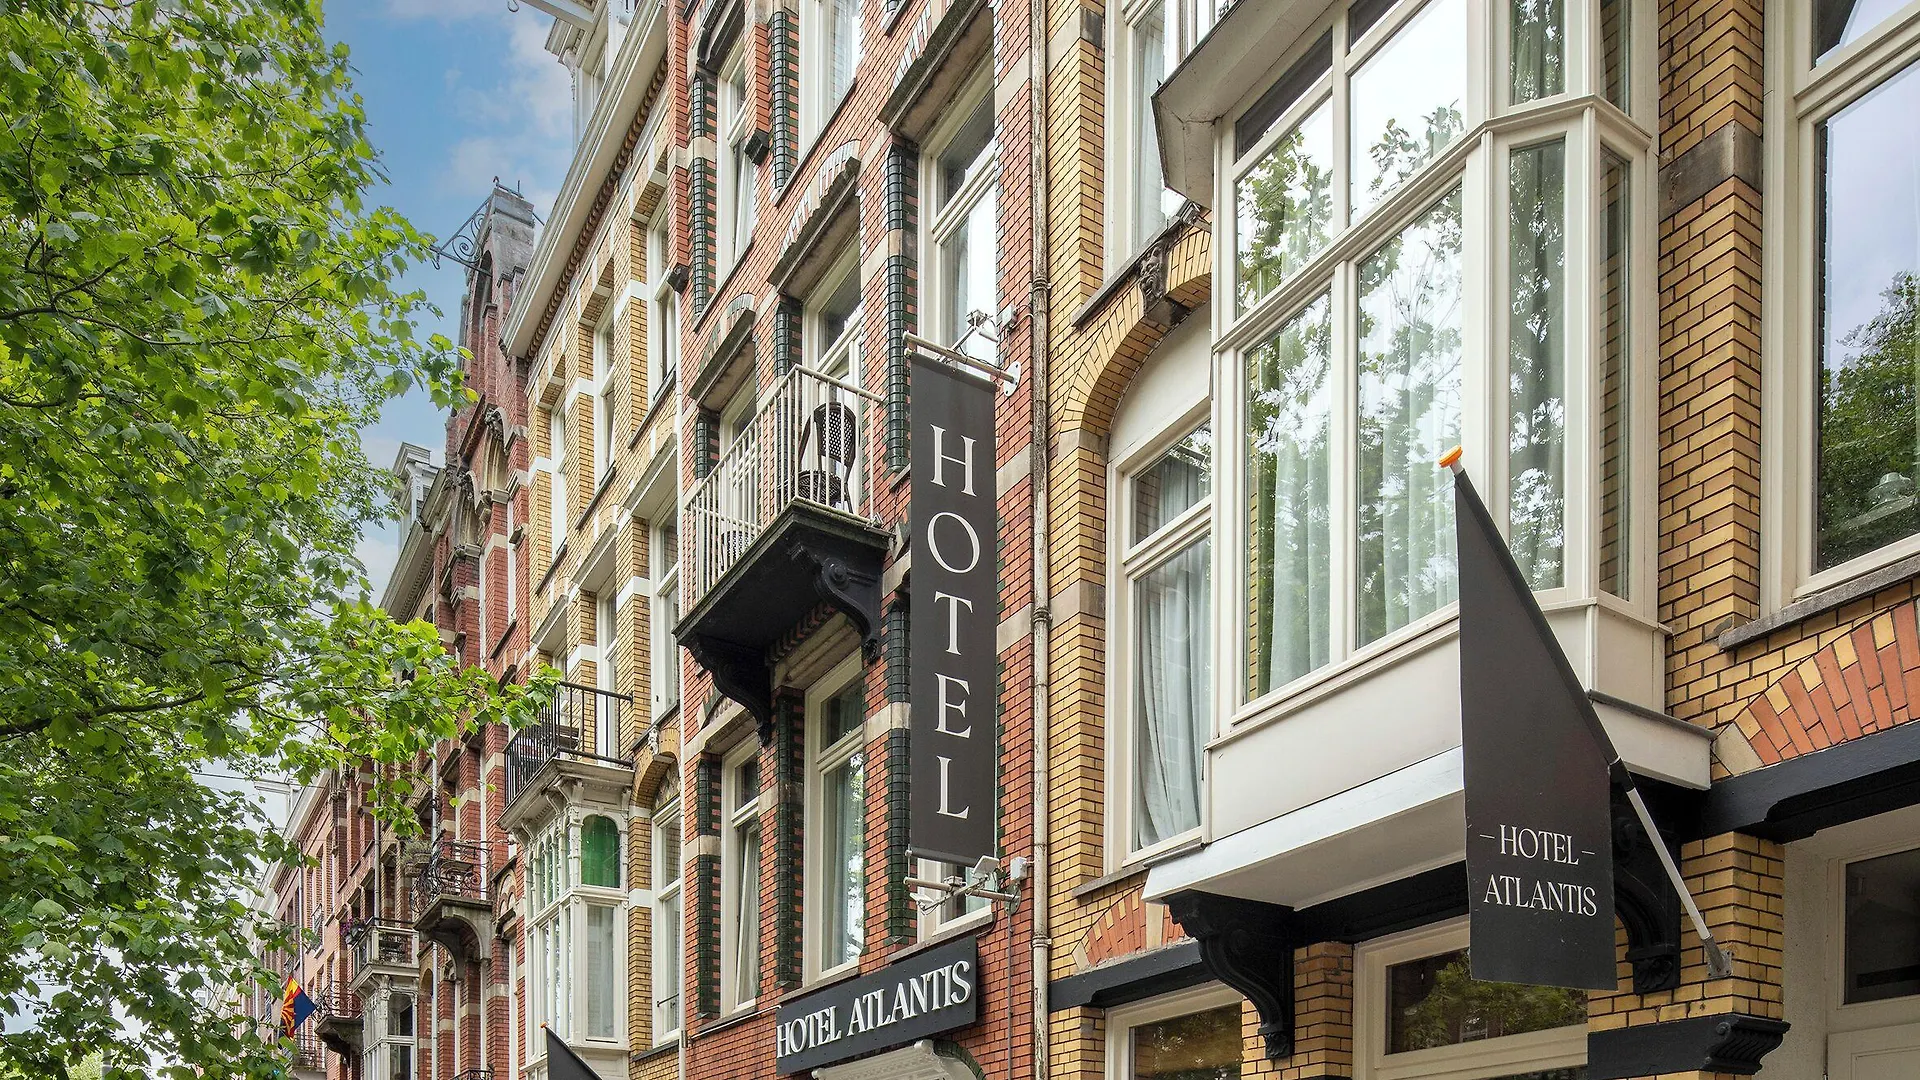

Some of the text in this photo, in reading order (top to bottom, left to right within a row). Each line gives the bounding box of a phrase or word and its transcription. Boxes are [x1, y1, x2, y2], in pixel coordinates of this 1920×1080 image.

[927, 423, 981, 820] HOTEL
[1499, 824, 1580, 866] HOTEL
[1483, 873, 1597, 917] ATLANTIS
[776, 960, 972, 1059] HOTEL ATLANTIS
